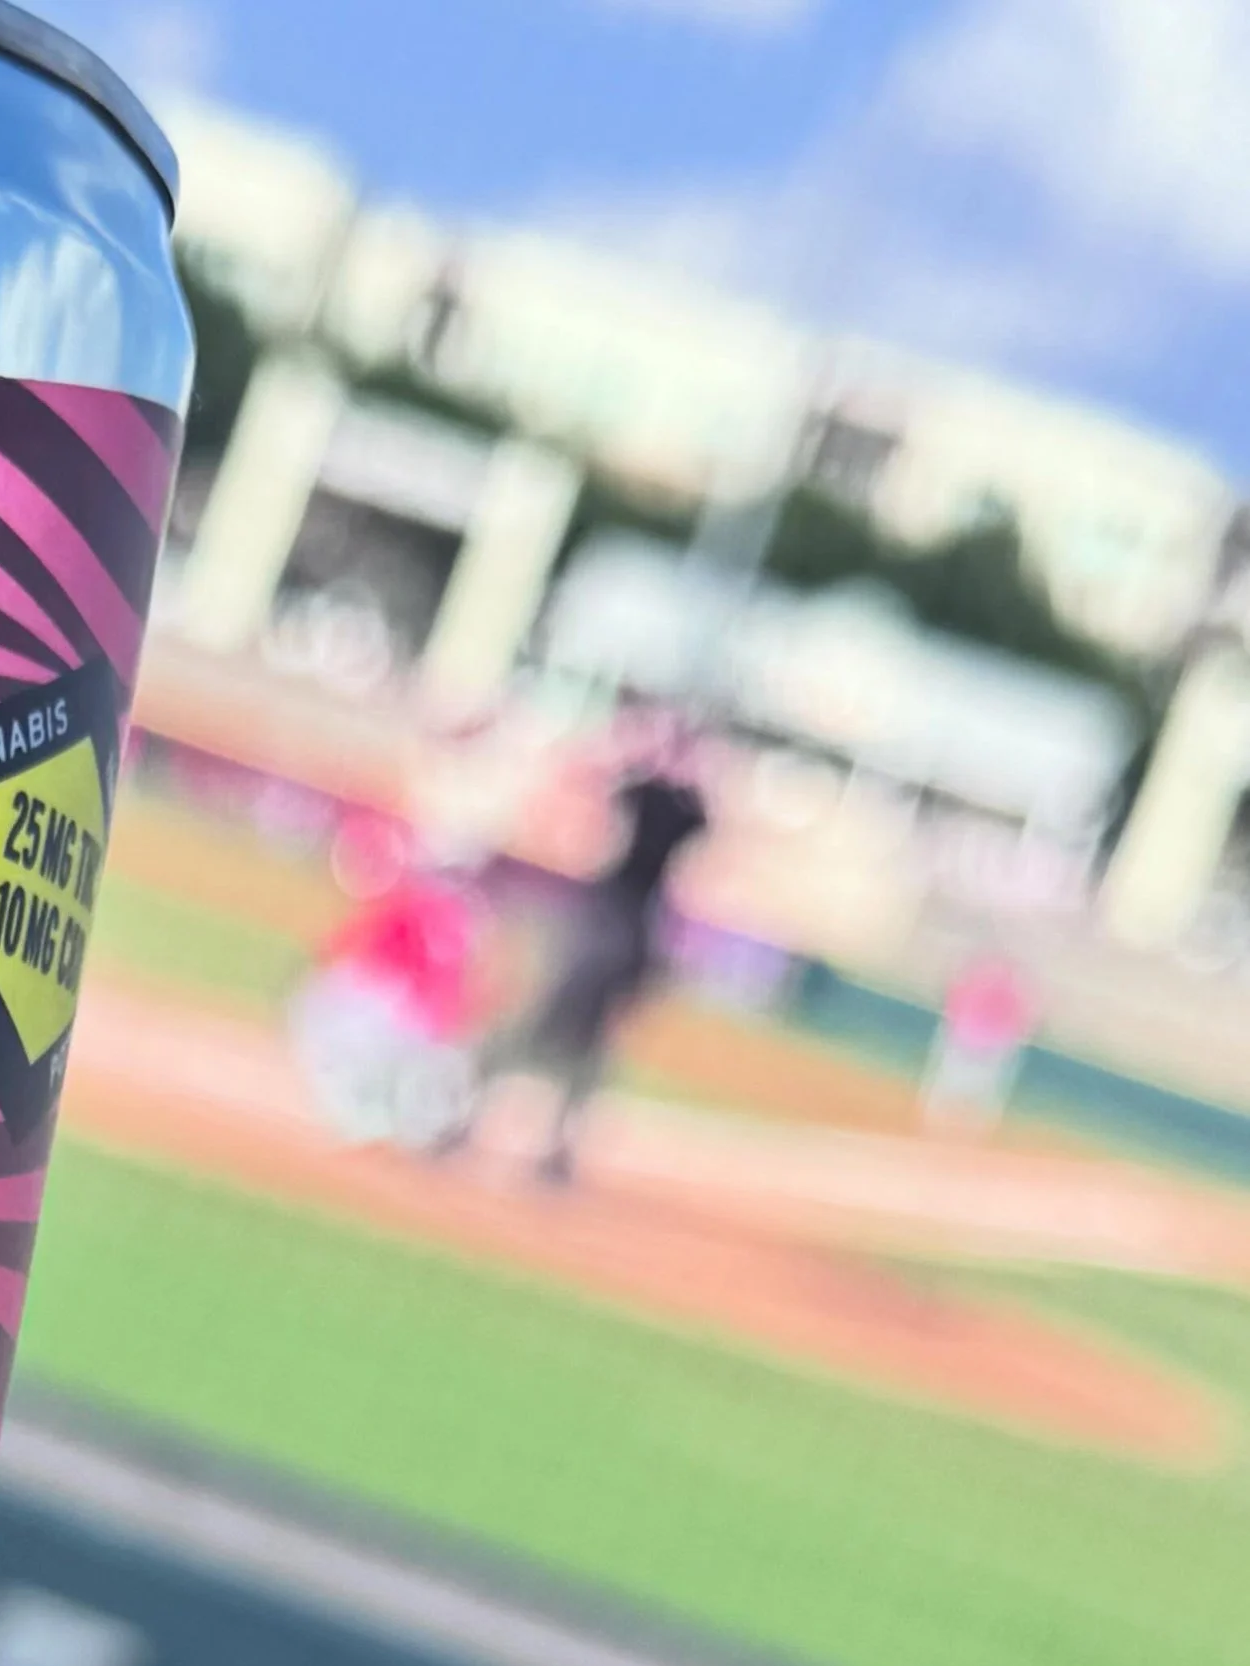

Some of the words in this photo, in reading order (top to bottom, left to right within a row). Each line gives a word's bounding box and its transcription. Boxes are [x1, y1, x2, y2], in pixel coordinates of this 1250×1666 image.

[3, 790, 46, 871] 25
[38, 807, 78, 891] MG
[20, 894, 60, 976] MG
